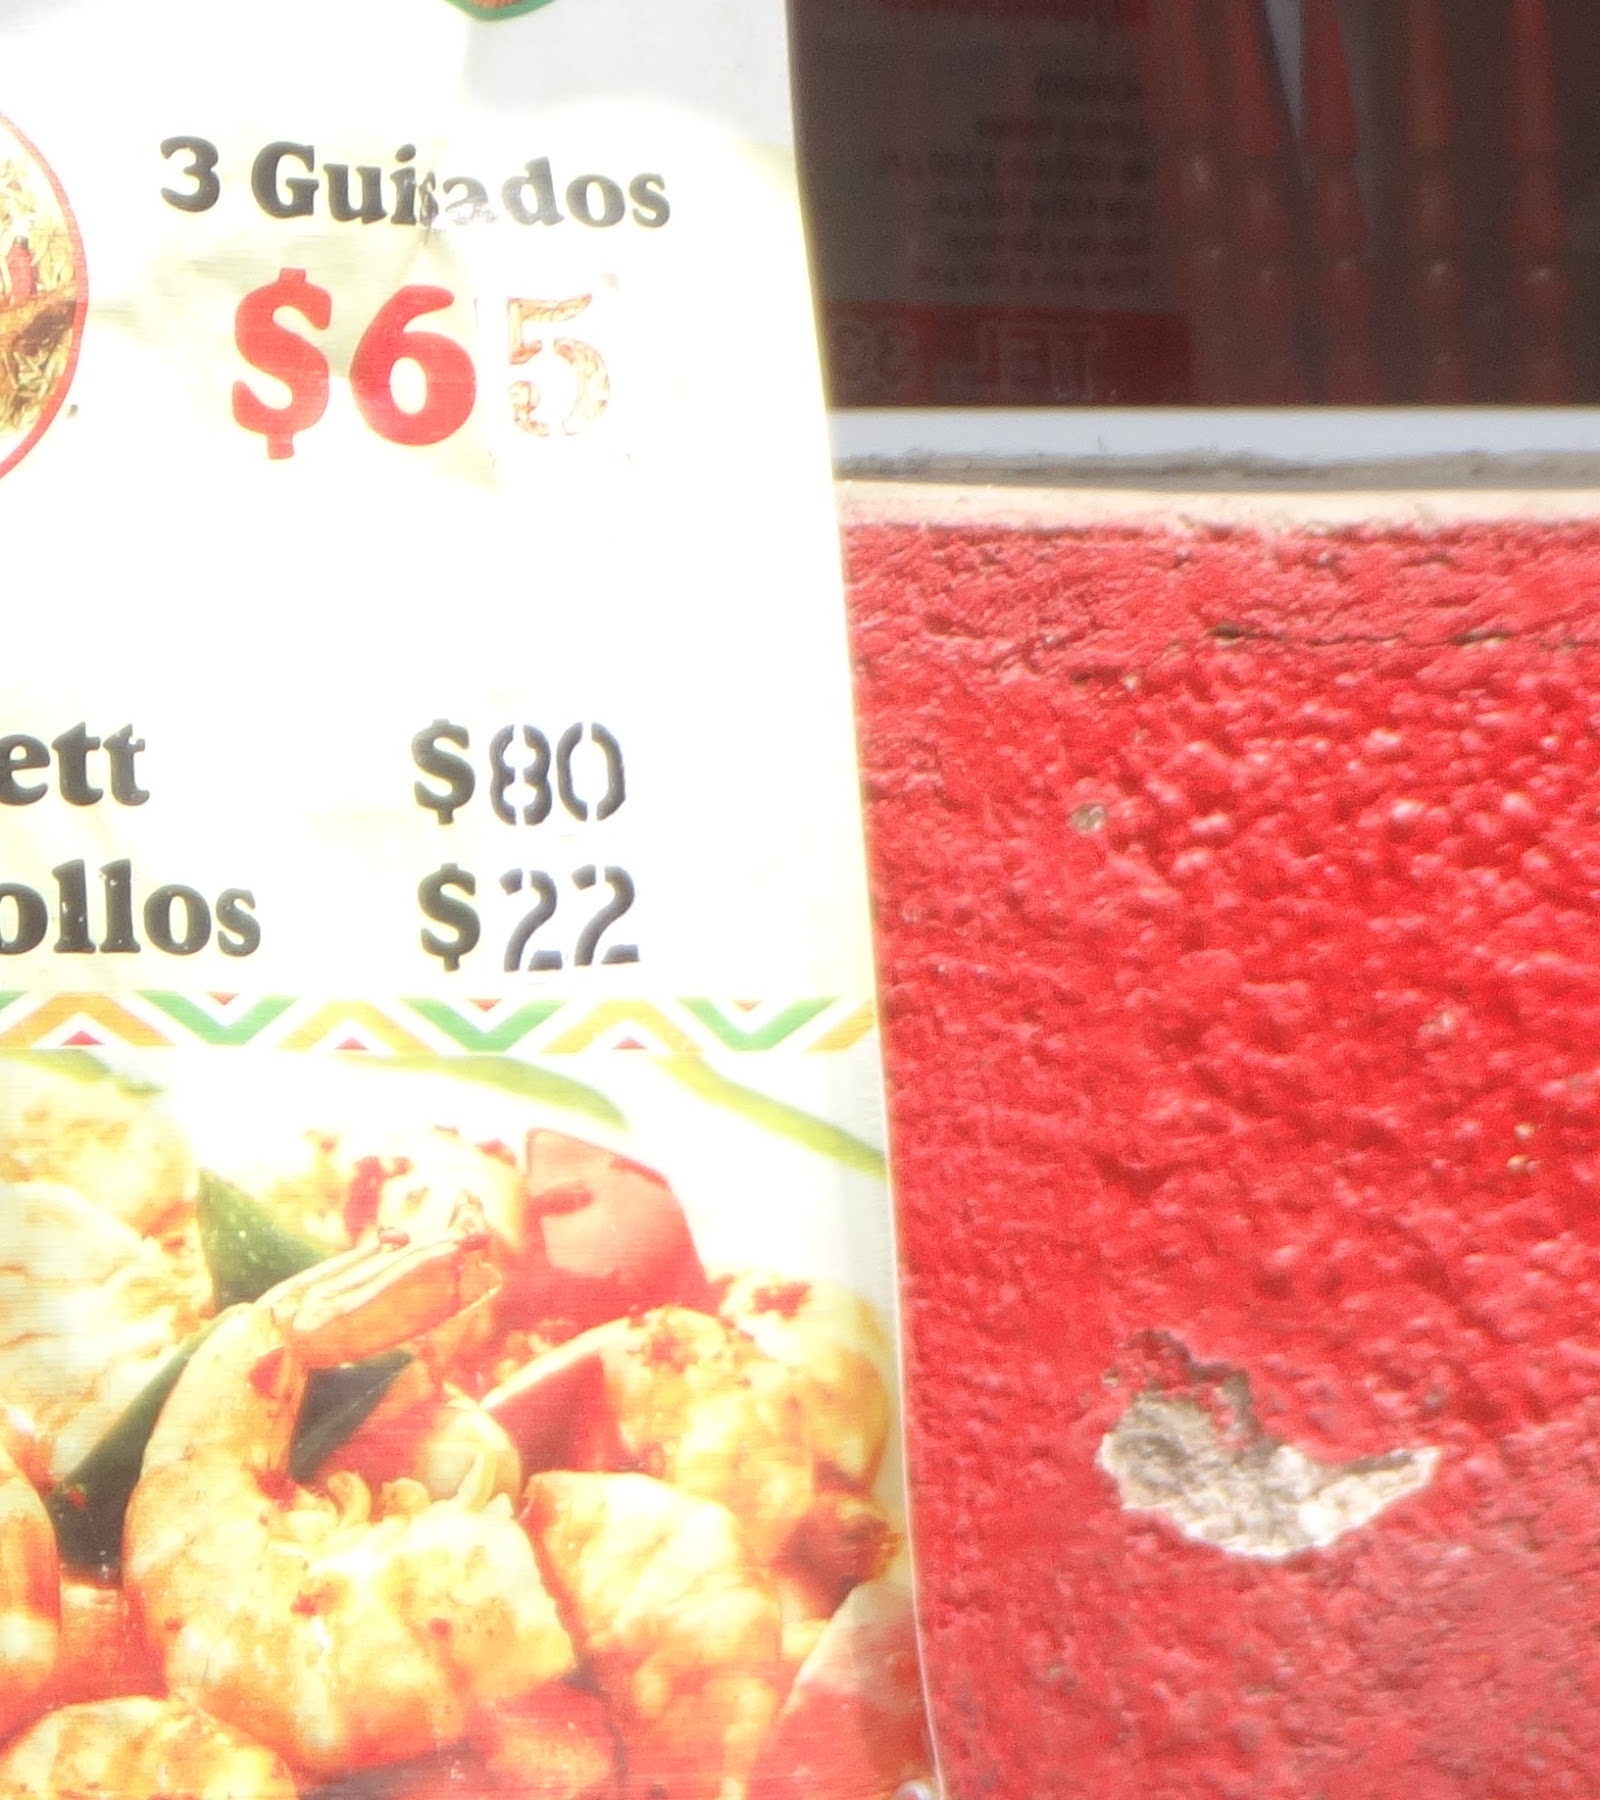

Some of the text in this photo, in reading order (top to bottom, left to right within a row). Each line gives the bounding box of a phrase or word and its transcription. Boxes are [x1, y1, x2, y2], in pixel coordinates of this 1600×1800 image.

[160, 135, 672, 230] 3 Guisados
[231, 267, 612, 460] $65
[413, 718, 628, 827] $80
[417, 862, 641, 973] $22
